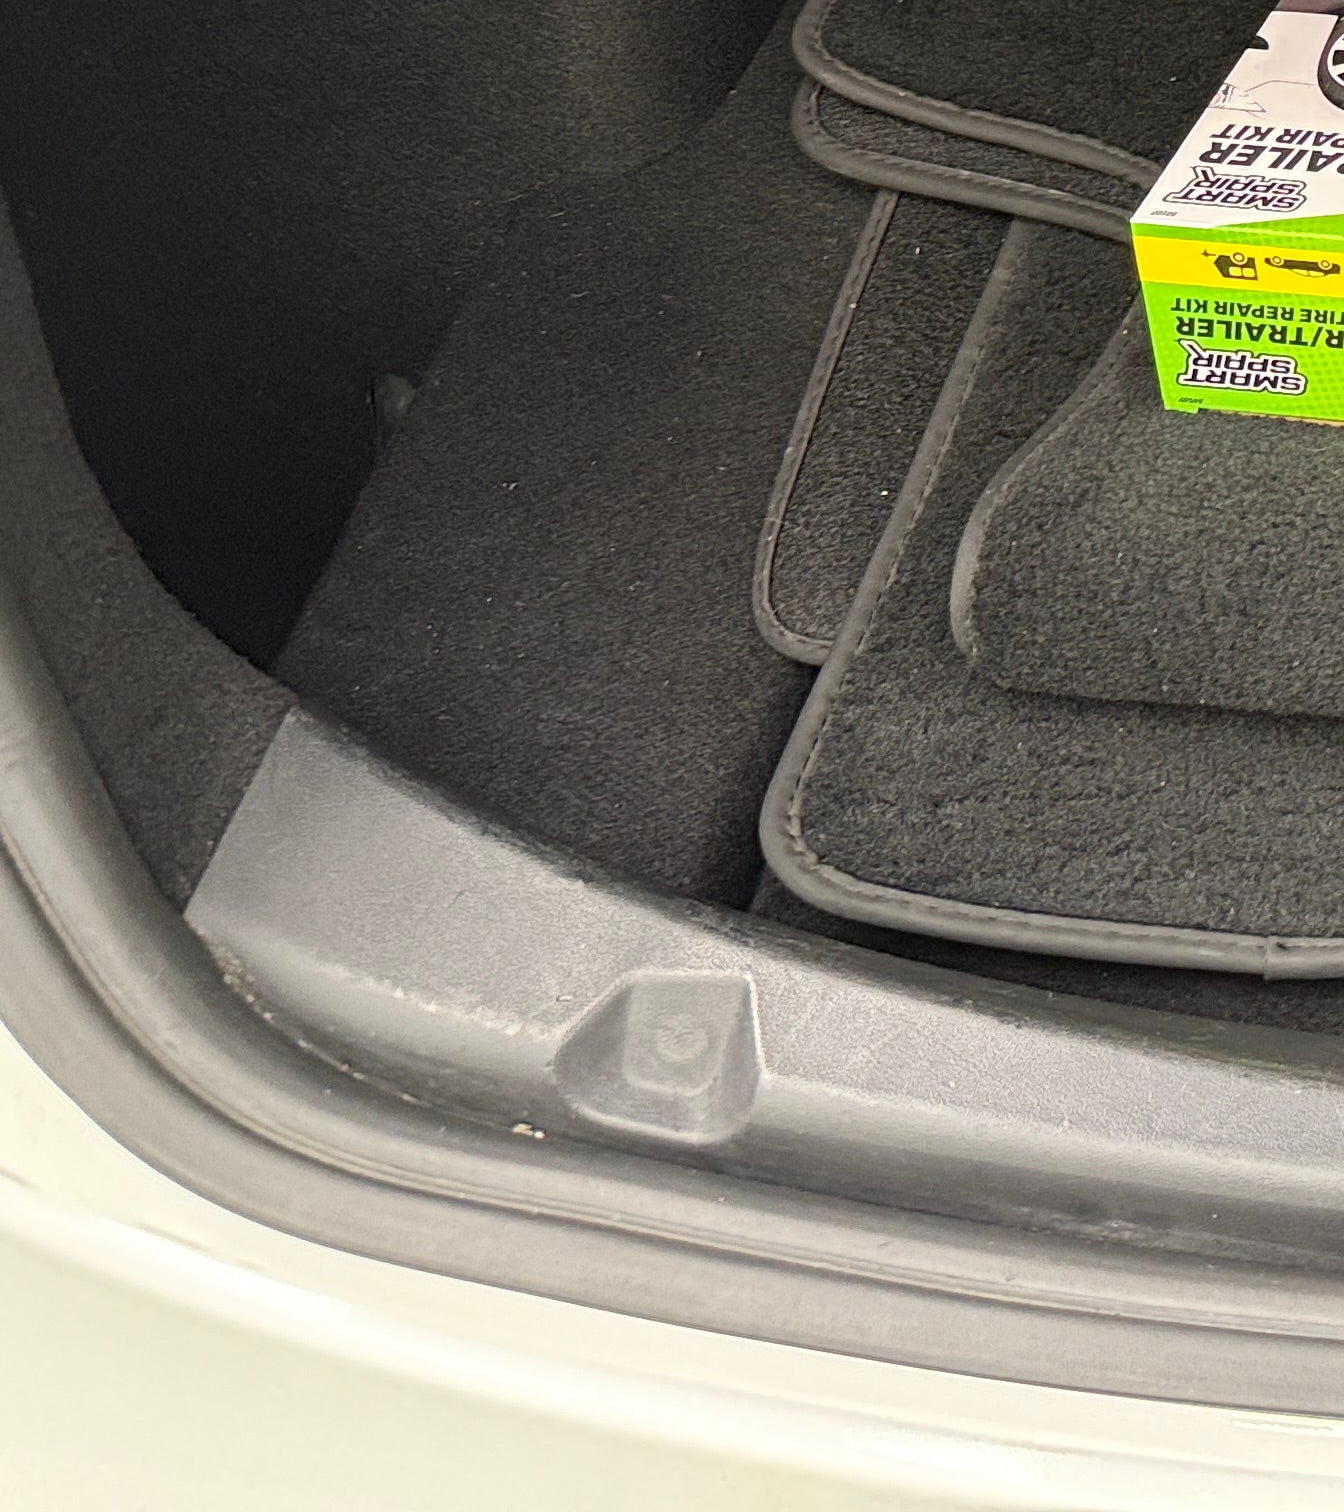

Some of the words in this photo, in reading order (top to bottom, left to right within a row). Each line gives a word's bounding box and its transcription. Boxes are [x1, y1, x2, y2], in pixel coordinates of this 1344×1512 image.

[1209, 123, 1271, 141] KIT
[1194, 170, 1299, 195] SPAIR
[1168, 190, 1298, 208] SMART
[1170, 298, 1208, 314] KIT
[1214, 300, 1294, 322] REPAIR
[1183, 342, 1292, 373] SPAIR
[1182, 368, 1302, 391] SMART
